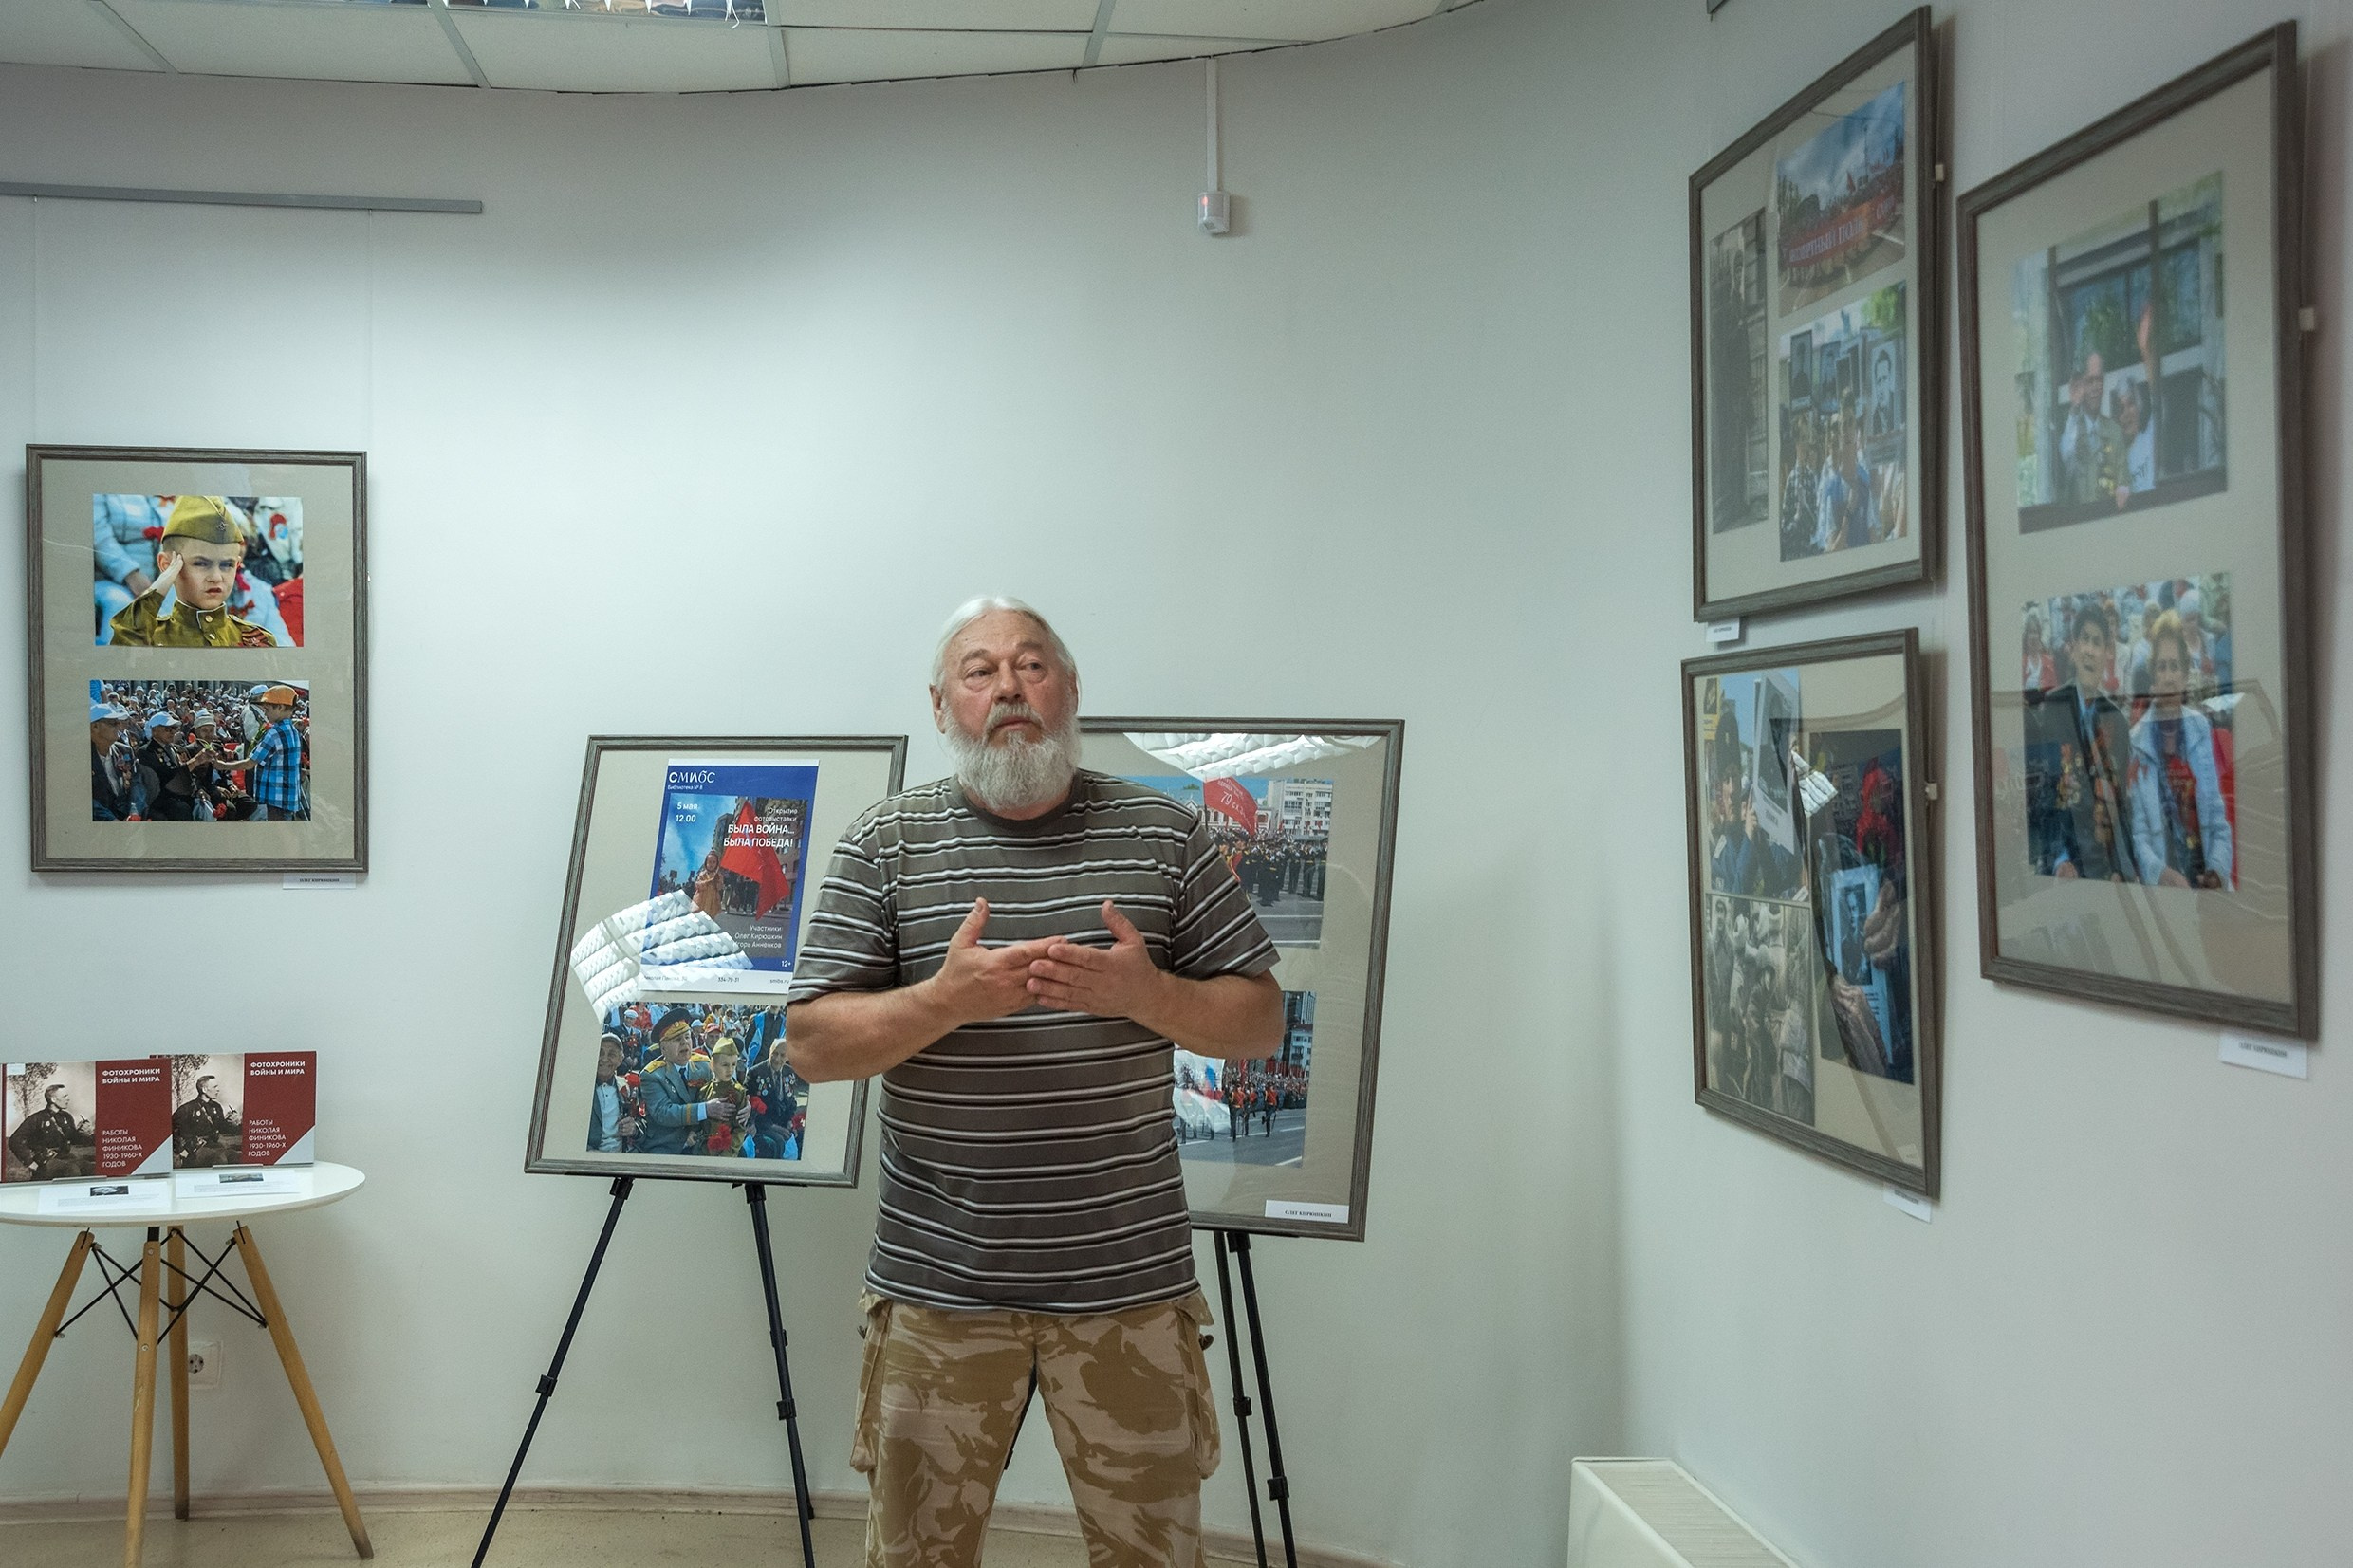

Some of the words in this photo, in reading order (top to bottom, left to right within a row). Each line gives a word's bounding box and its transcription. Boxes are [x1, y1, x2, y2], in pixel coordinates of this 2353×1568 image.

[676, 802, 682, 810] 5
[676, 814, 696, 822] 12.00
[728, 824, 754, 834] БЫЛА
[723, 838, 750, 847] БЫЛА
[752, 838, 793, 848] ПОБЕДА!
[102, 1068, 161, 1077] ФОТОХРОНИКИ
